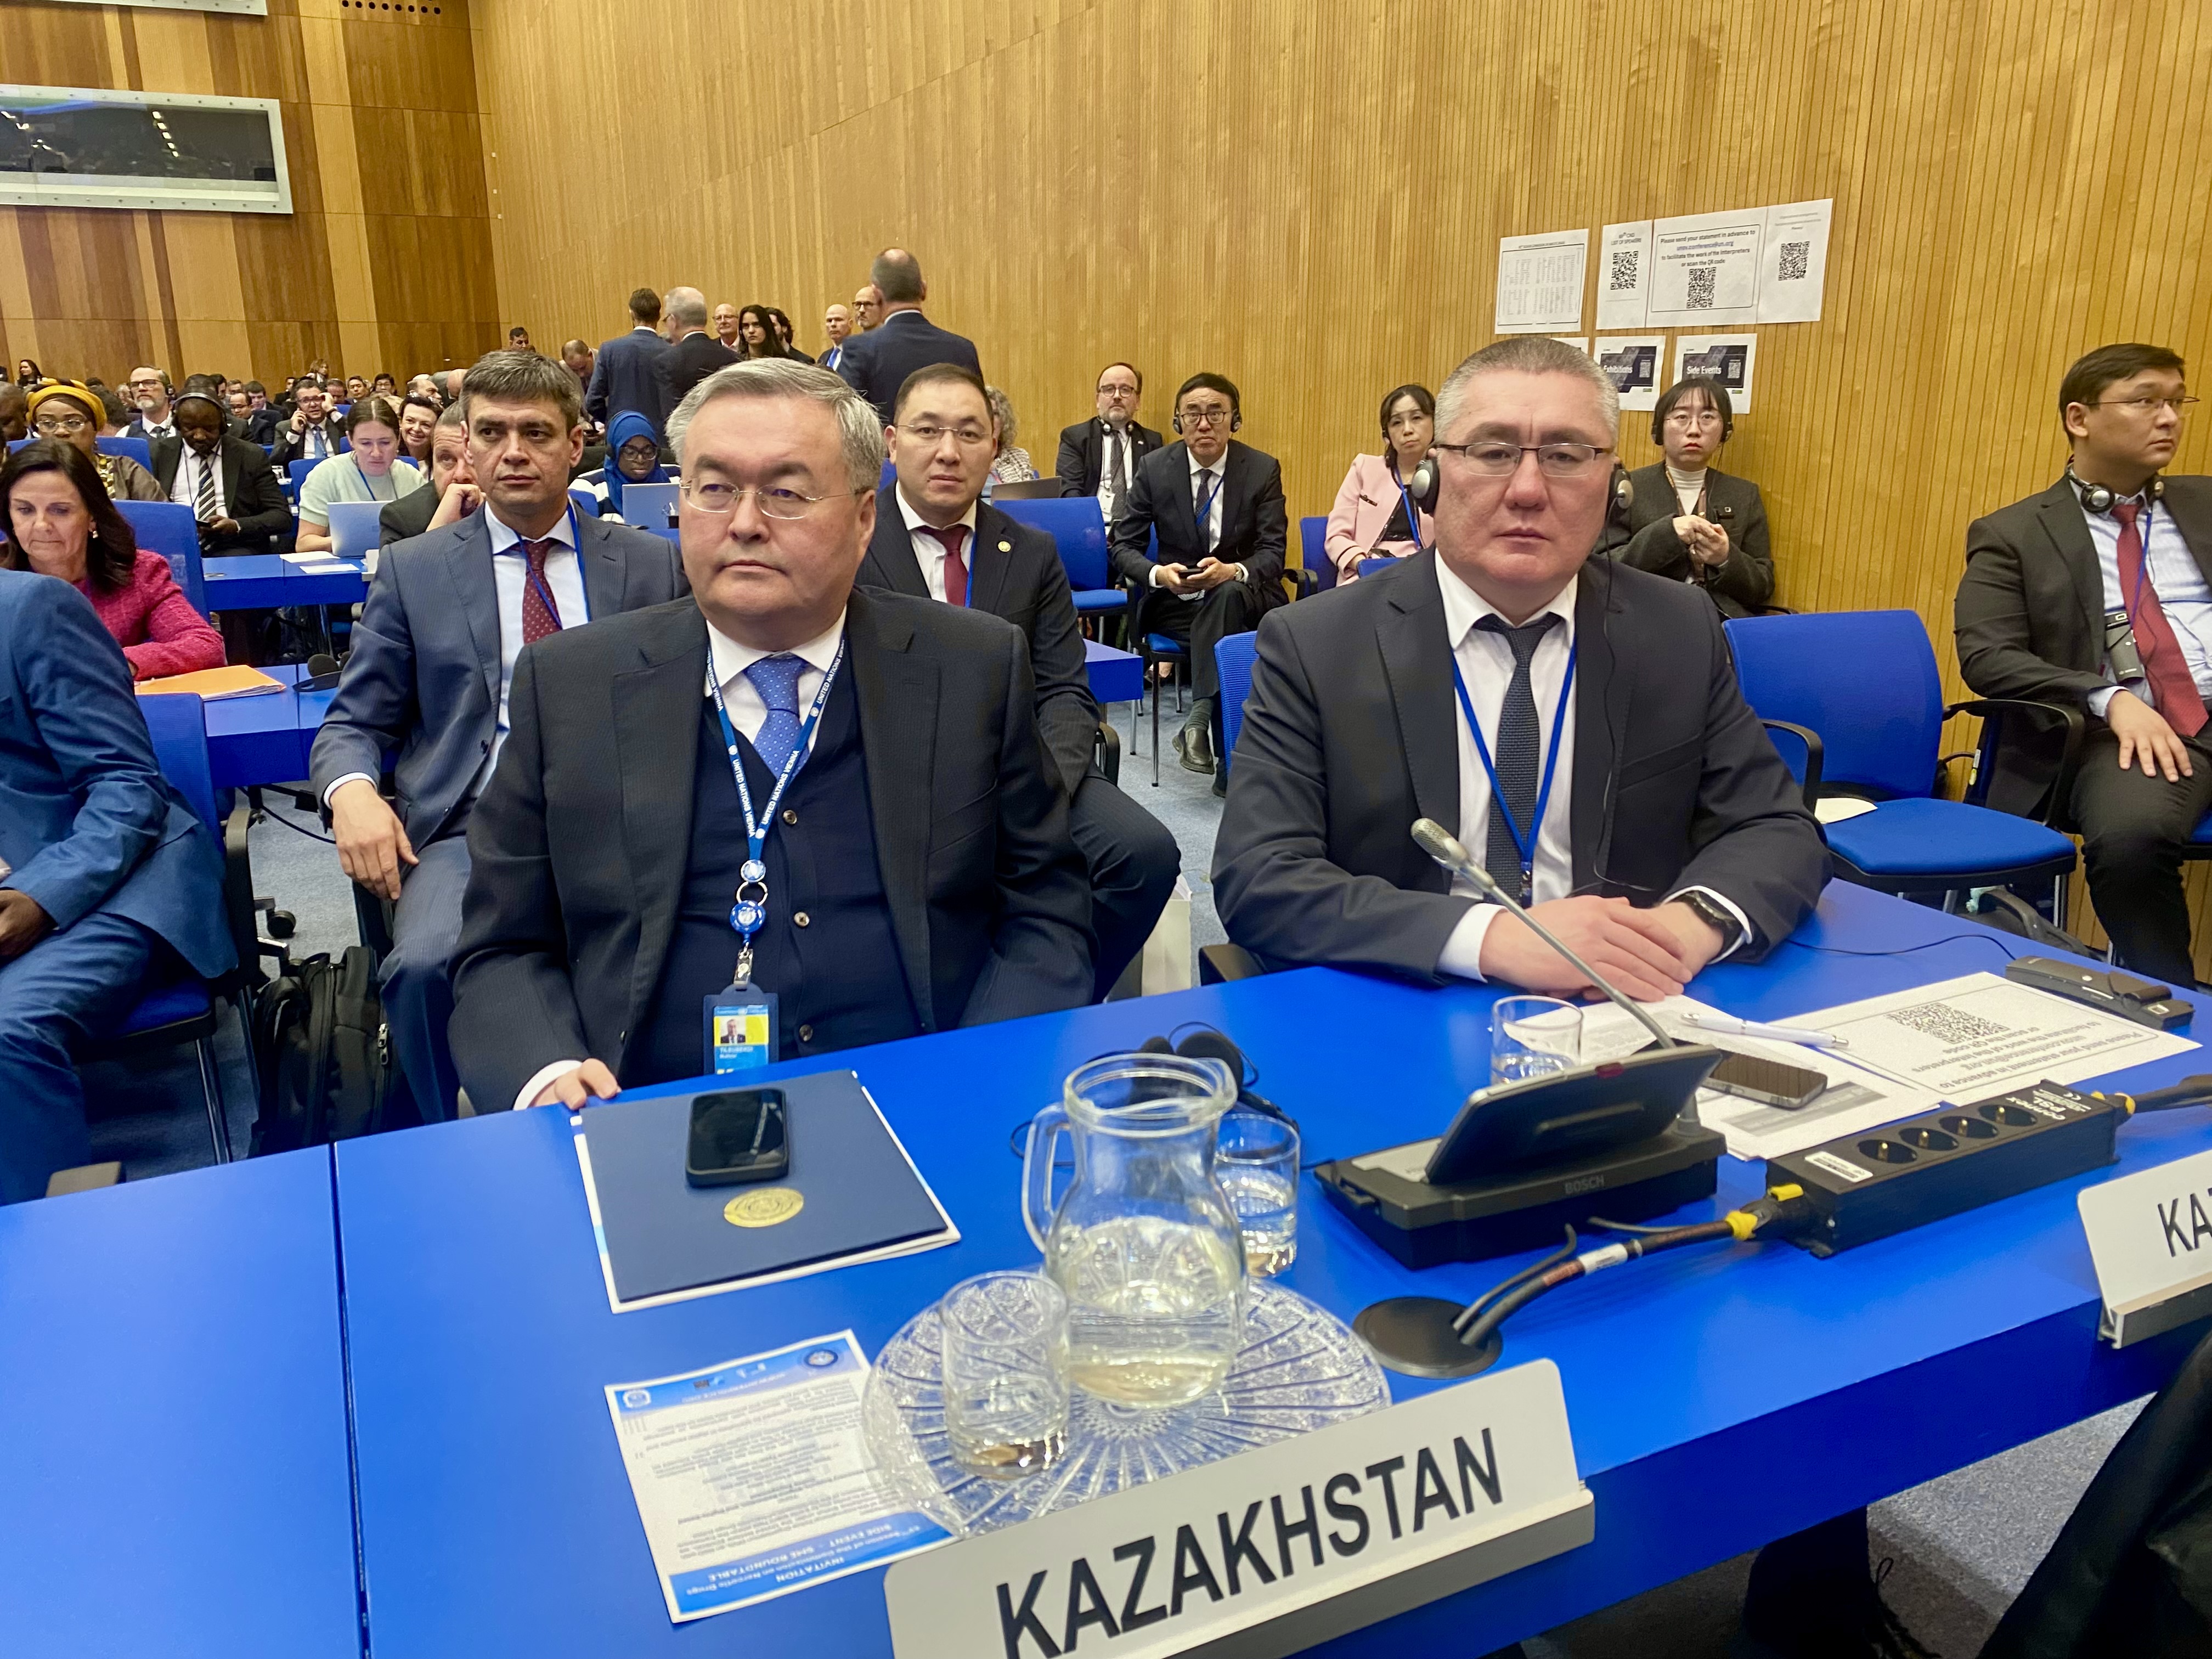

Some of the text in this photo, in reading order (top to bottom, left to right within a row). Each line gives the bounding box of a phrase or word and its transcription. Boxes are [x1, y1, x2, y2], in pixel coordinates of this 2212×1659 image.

[1687, 365, 1722, 375] Side Events
[816, 682, 830, 704] UNITED
[826, 657, 841, 682] NATIONS
[713, 687, 724, 712] VIENNA
[732, 759, 755, 838] UNITED NATIONS VIENNA
[761, 750, 800, 825] UNITED NATIONS VIENNA
[2033, 1097, 2067, 1113] PSL
[1565, 1175, 1604, 1194] BOSCH
[2158, 1188, 2212, 1257] KA
[829, 1530, 865, 1548] EVENT
[996, 1427, 1503, 1659] KAZAKHSTAN
[708, 1554, 789, 1583] ROUNDTABLE
[775, 1556, 845, 1583] INVITATION
